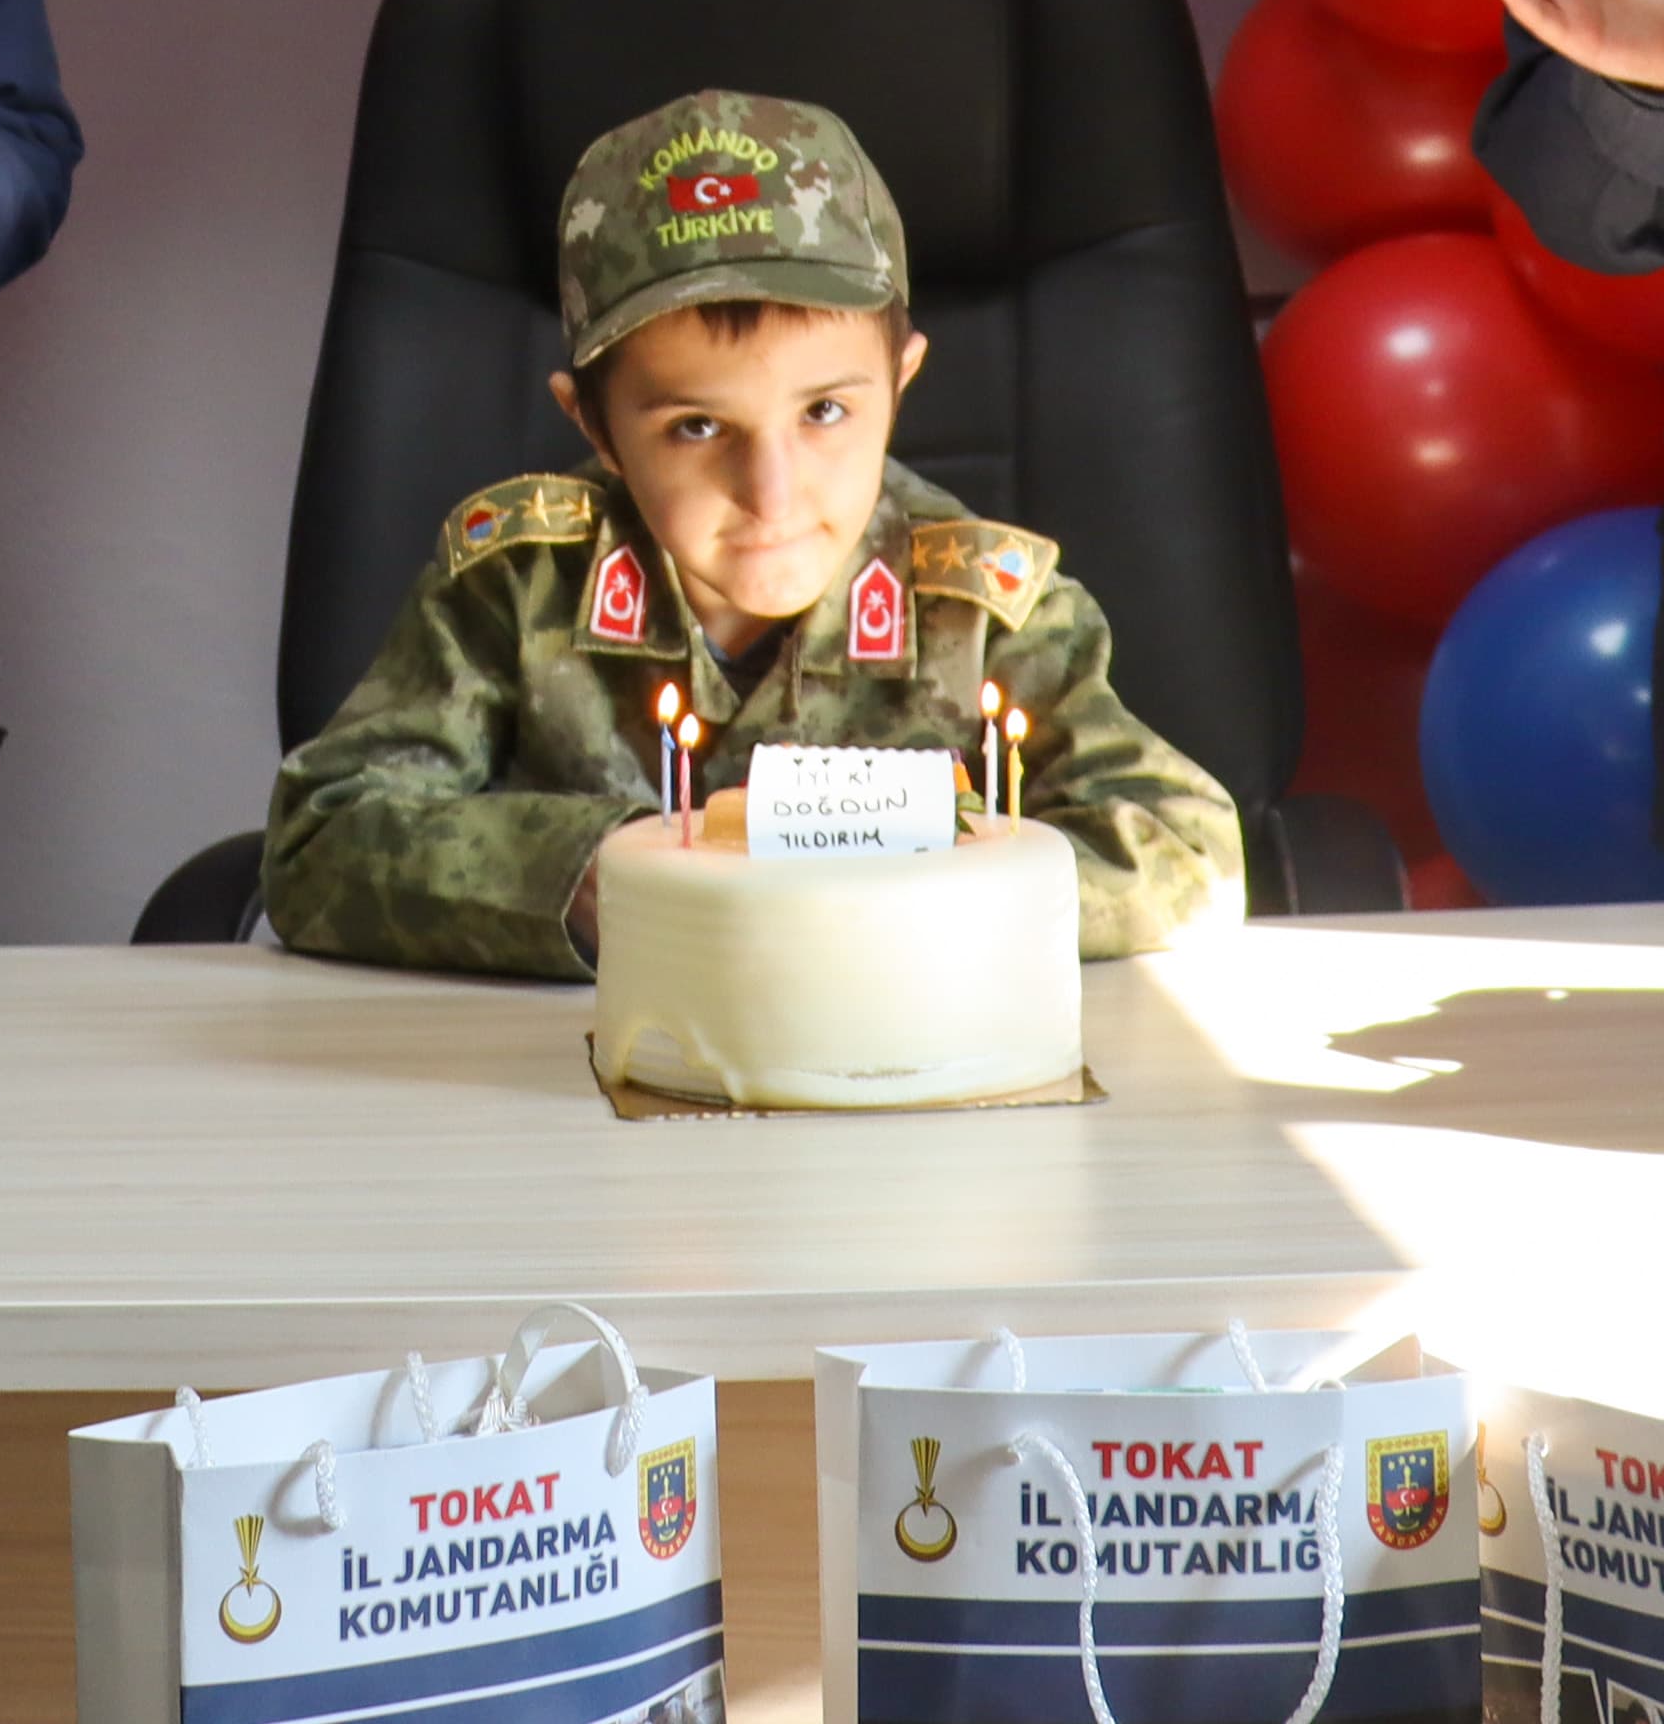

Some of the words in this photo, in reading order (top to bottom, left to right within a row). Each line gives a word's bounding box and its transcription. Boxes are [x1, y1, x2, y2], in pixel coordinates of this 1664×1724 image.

[639, 127, 779, 191] KOMANDO
[773, 787, 908, 817] DOĞDUN
[779, 827, 885, 849] YILDIRIM
[1092, 1440, 1264, 1480] TOKAT
[409, 1472, 561, 1533] TOKAT
[1021, 1481, 1062, 1526] İL
[340, 1547, 382, 1592] İL
[392, 1509, 617, 1584] JANDARMA
[338, 1552, 620, 1642] KOMUTANLIĞI
